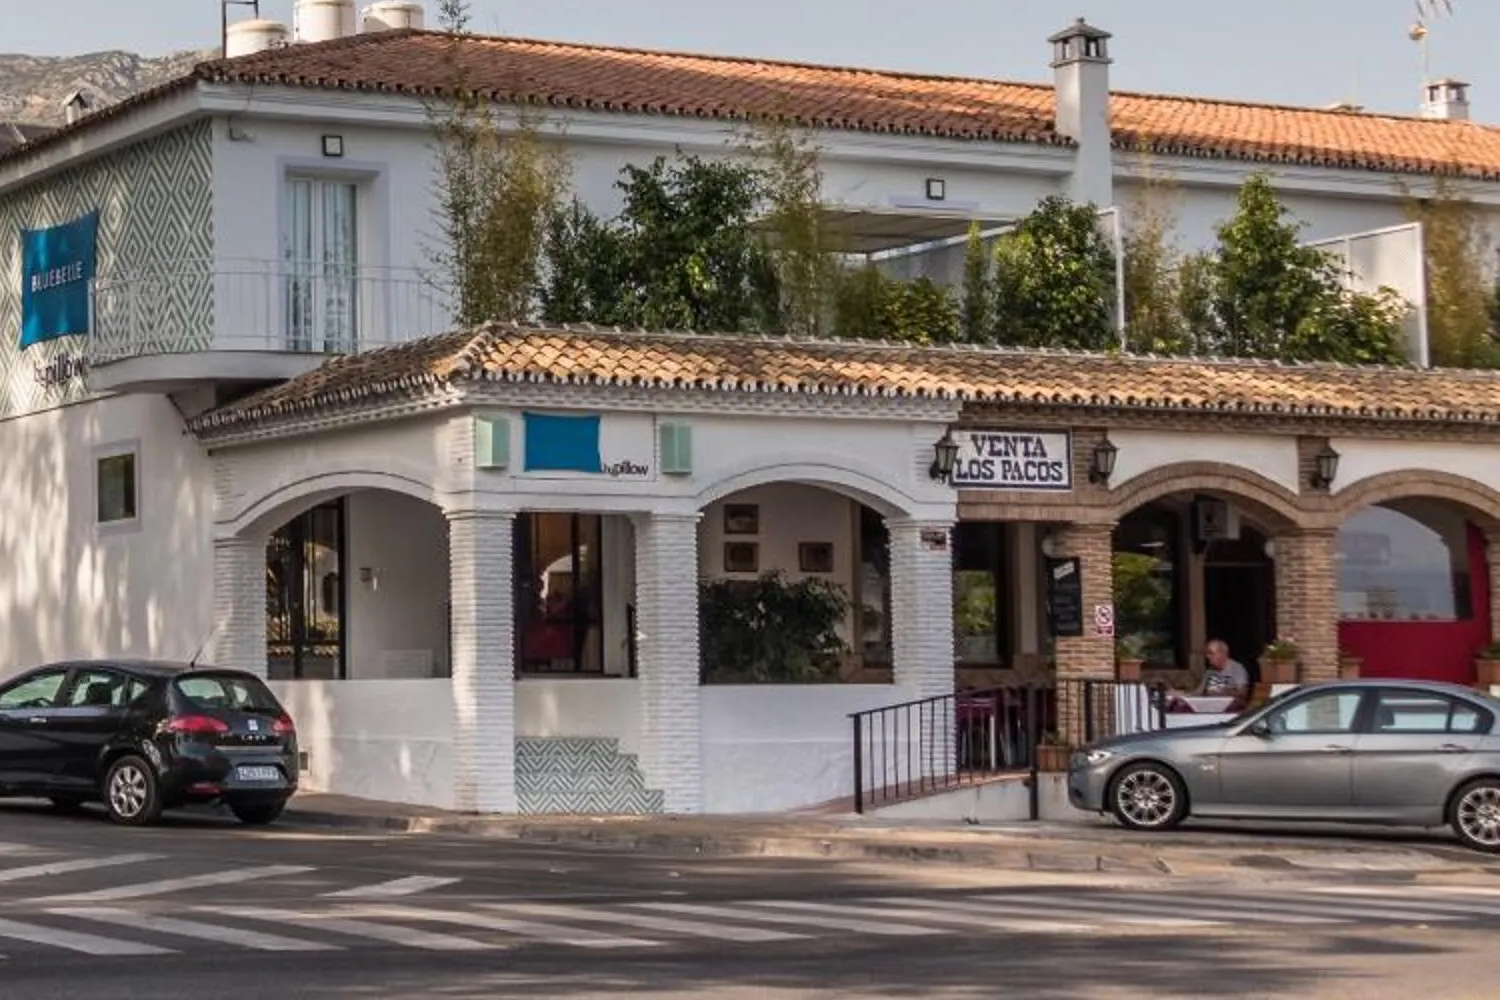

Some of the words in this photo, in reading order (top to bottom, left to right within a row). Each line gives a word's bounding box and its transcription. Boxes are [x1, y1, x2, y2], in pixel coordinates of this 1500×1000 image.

[970, 434, 1047, 458] VENTA
[955, 459, 995, 481] LOS
[1002, 460, 1063, 482] PACOS
